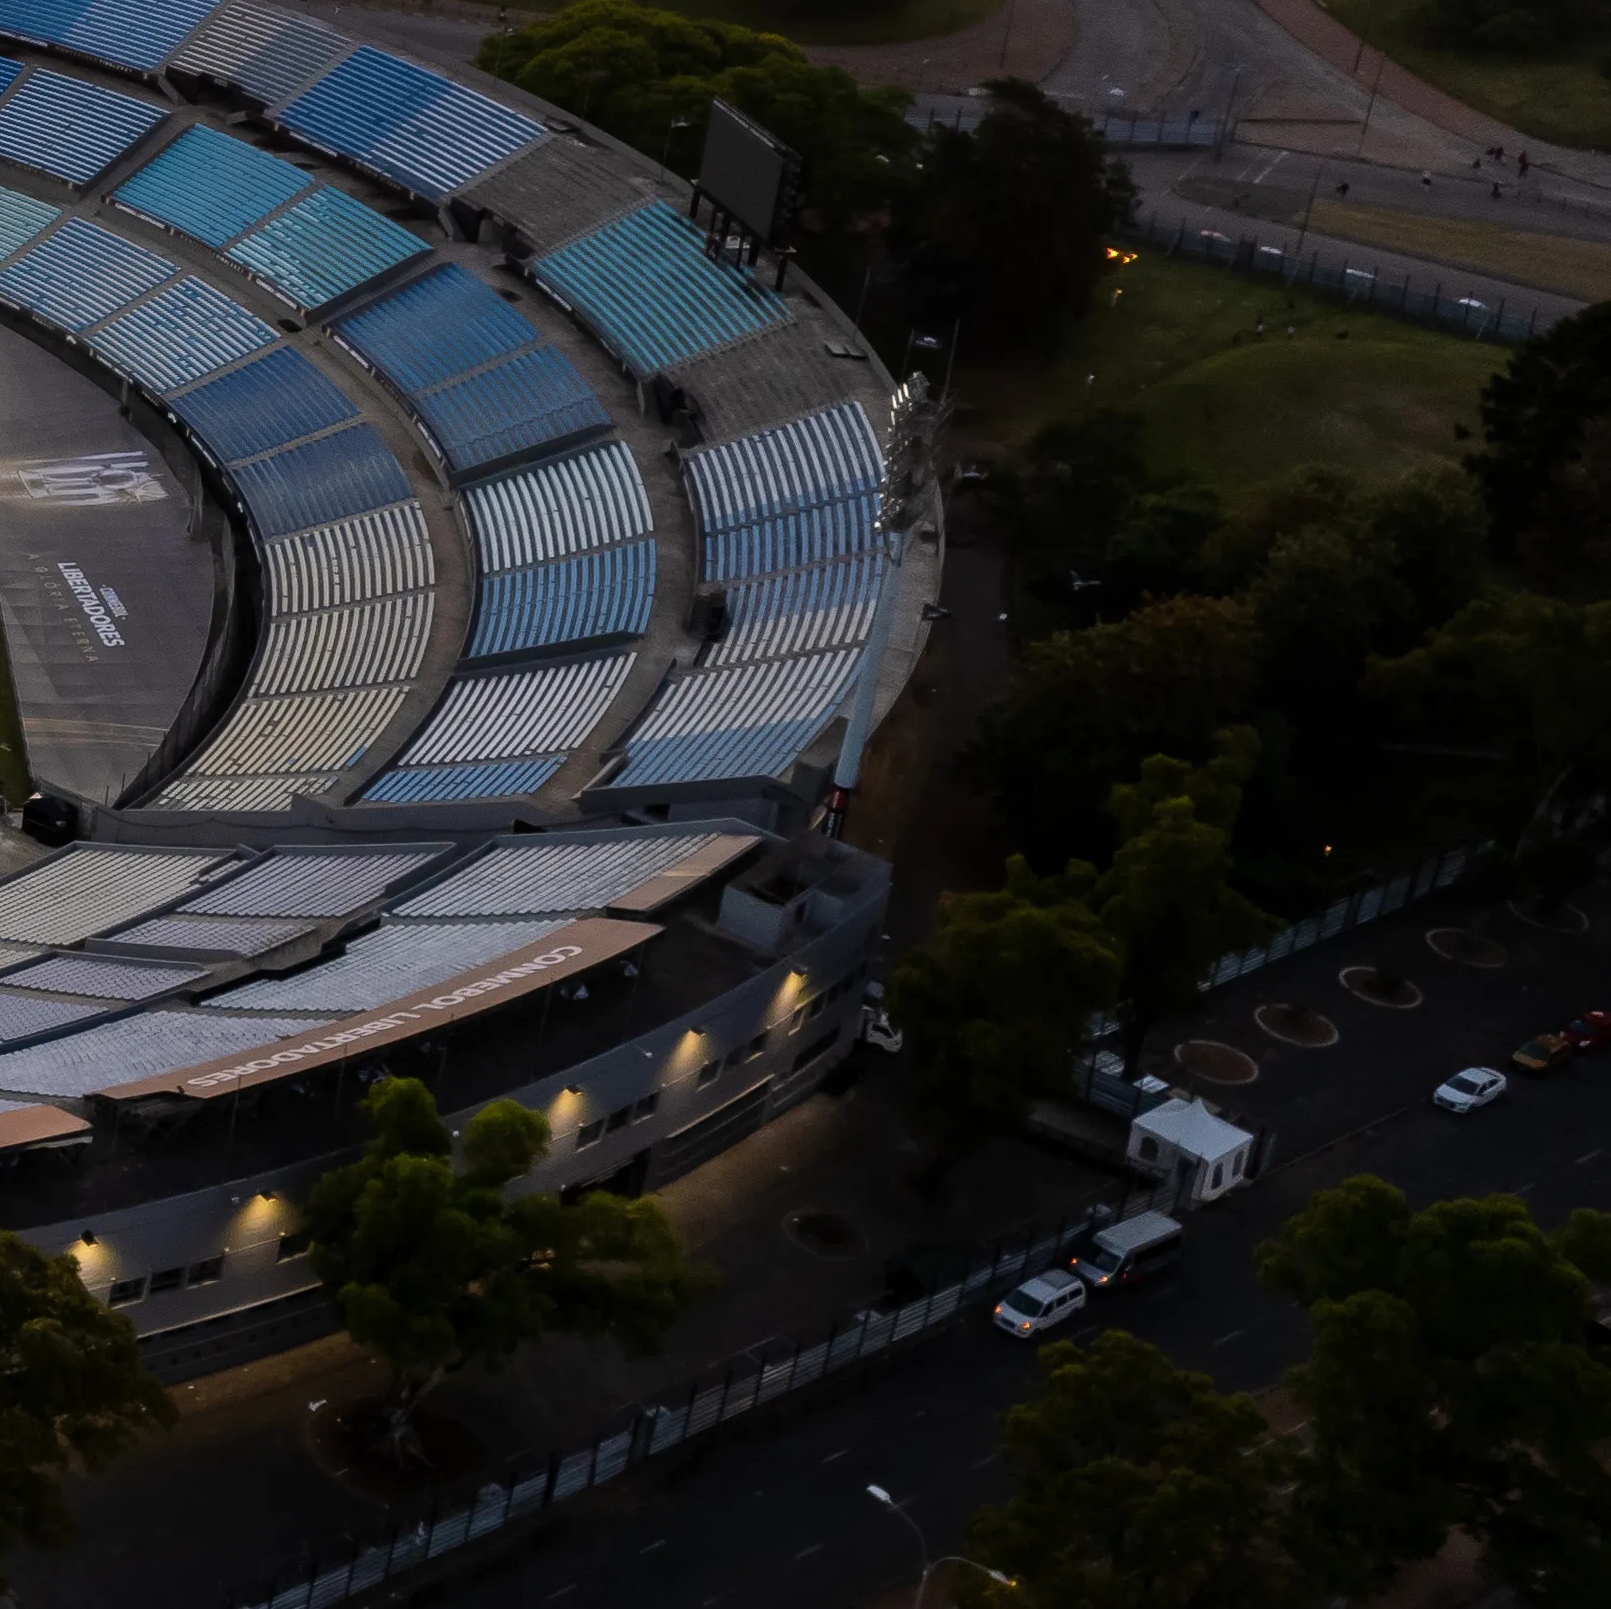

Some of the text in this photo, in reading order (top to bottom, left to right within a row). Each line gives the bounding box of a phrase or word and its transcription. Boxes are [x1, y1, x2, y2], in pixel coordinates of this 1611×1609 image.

[57, 561, 126, 648] LIBERTADORES
[187, 944, 584, 1089] CONMEBOL LIBERTADORES
